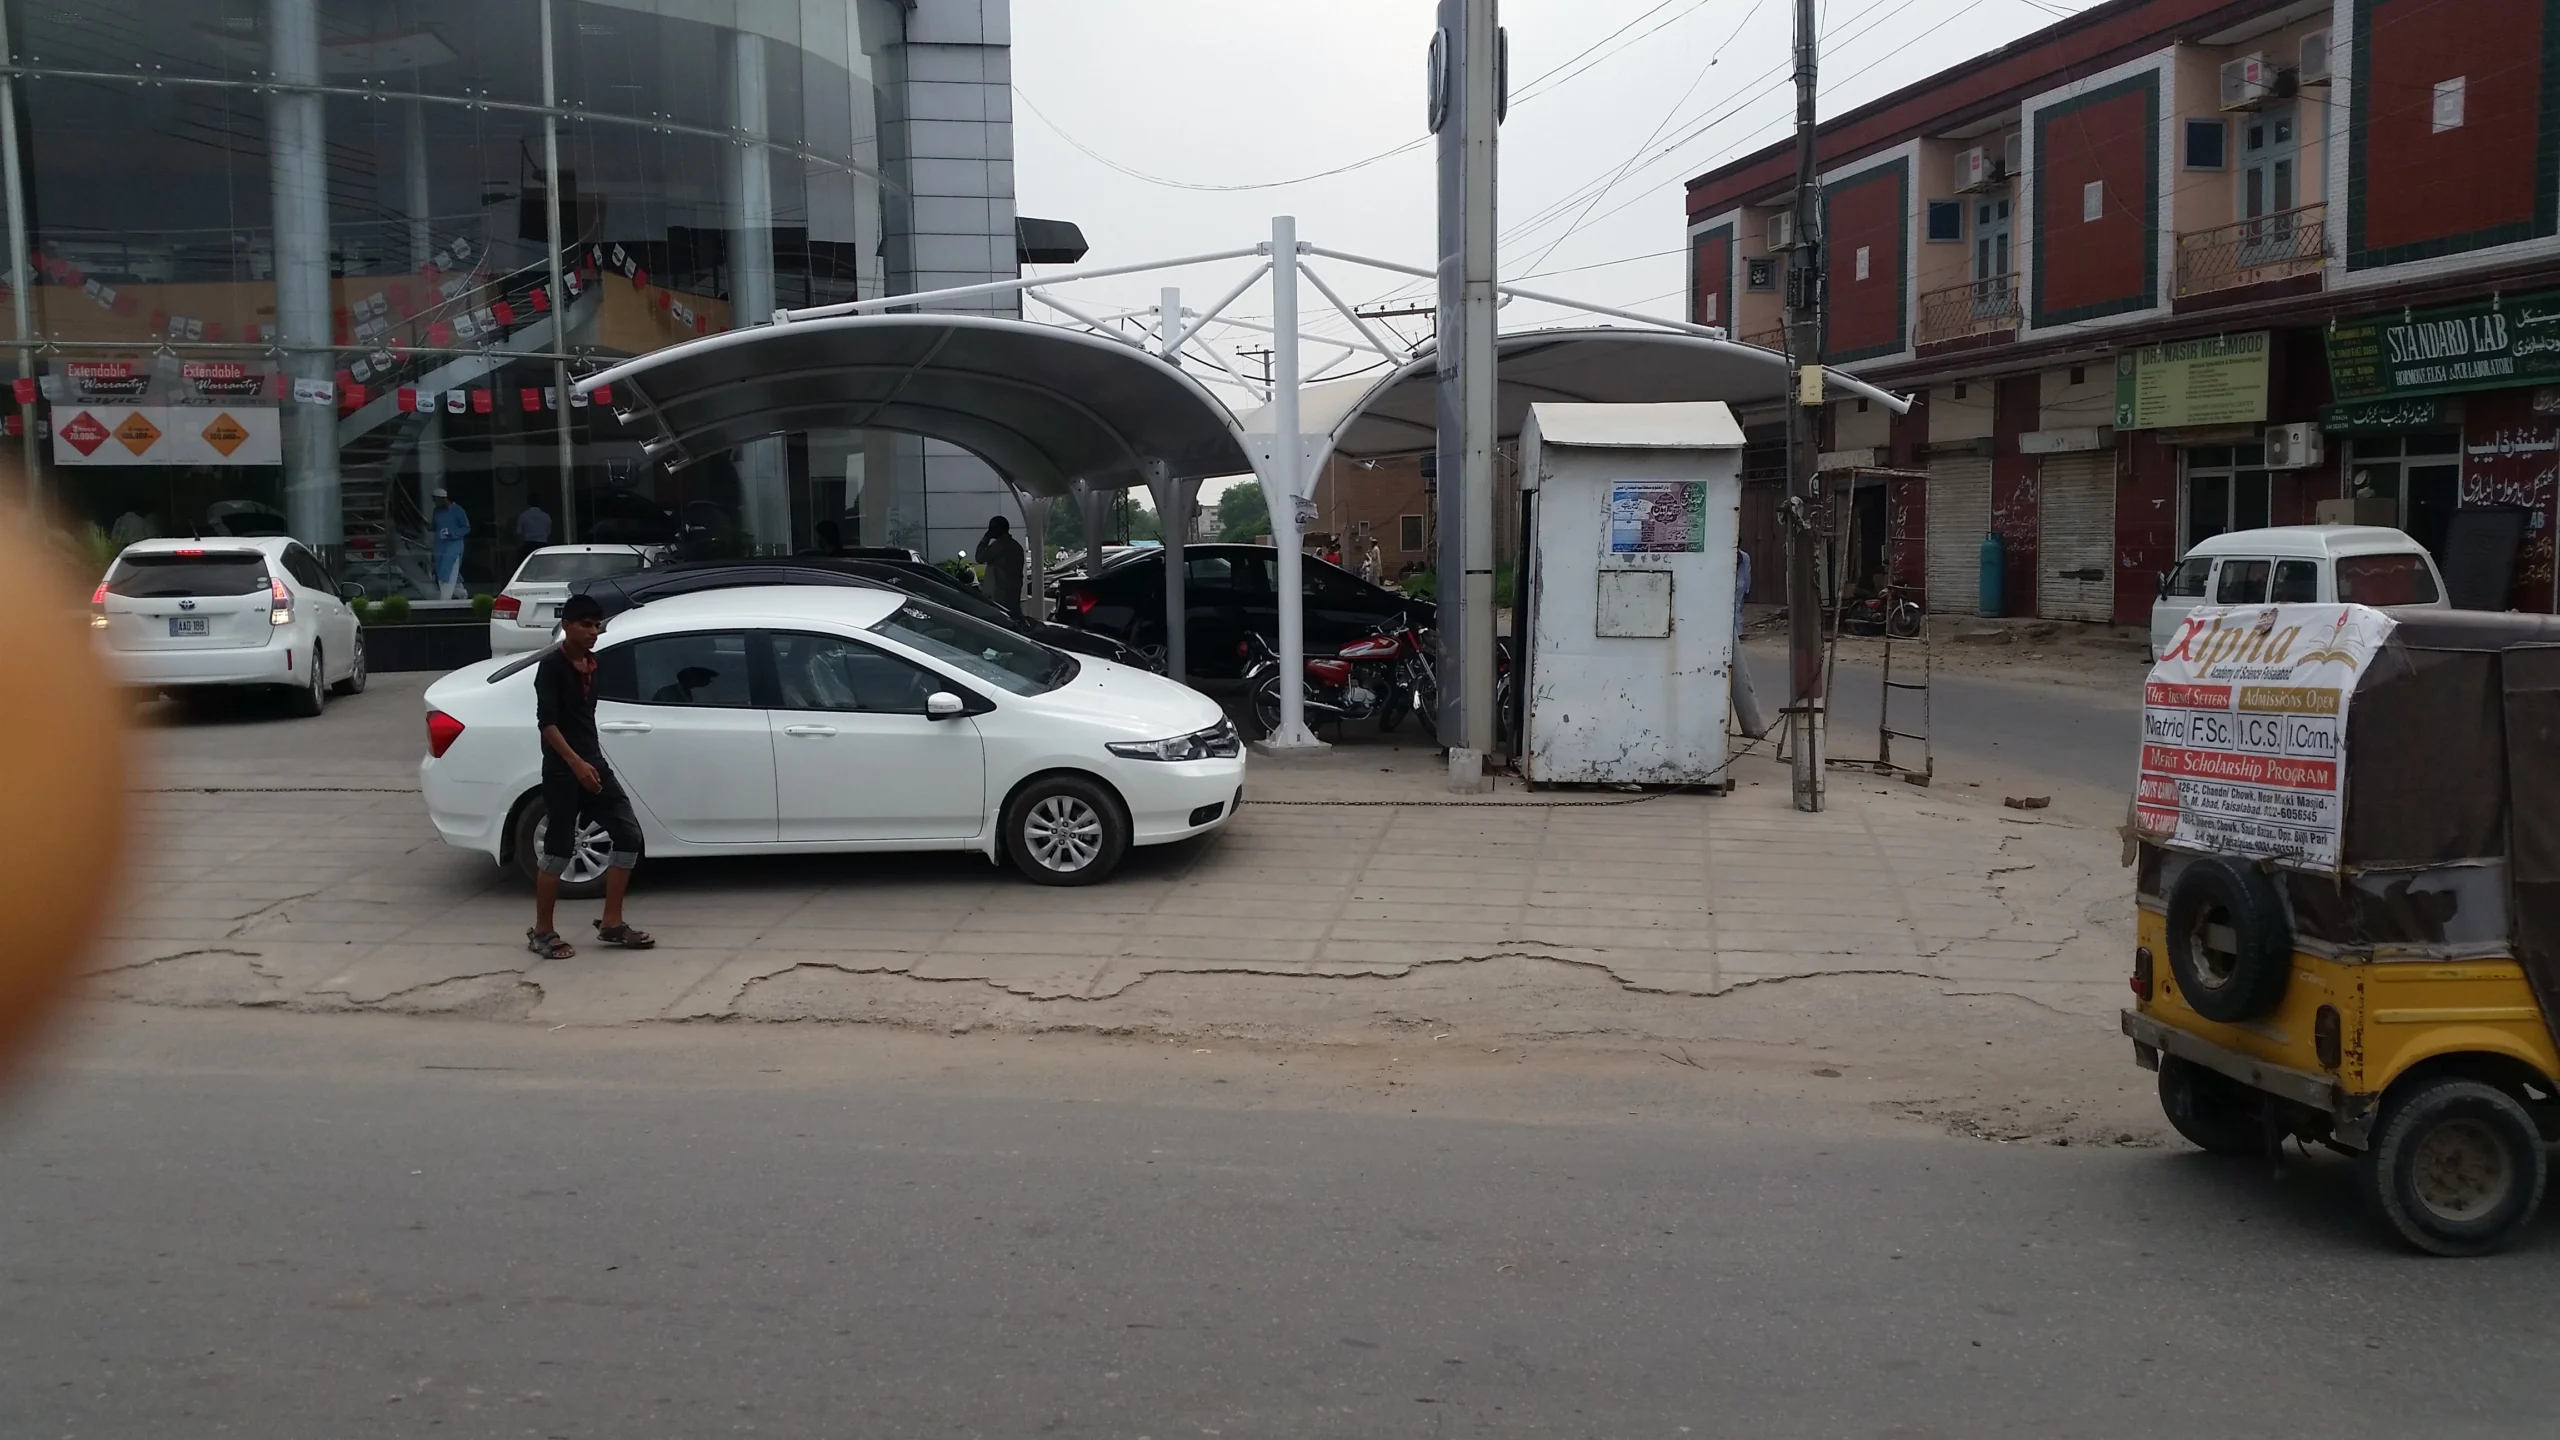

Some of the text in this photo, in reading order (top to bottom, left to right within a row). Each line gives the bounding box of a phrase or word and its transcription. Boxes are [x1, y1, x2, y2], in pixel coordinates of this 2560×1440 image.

[2387, 319, 2468, 363] STANDARD
[2469, 313, 2508, 352] LAB
[2165, 342, 2198, 362] NASIR
[2202, 335, 2263, 358] MEHMOOD
[68, 364, 126, 377] Extendable
[183, 365, 241, 378] Extendable
[2530, 511, 2546, 529] AB
[2209, 666, 2232, 683] Academy
[2240, 667, 2261, 680] Science
[2261, 667, 2293, 680] Faisalabad
[2193, 689, 2228, 706] SETTERS
[2192, 717, 2231, 744] F.Sc.
[2239, 719, 2280, 747] I.C.S.
[2289, 724, 2334, 750] I.Com.
[2202, 785, 2229, 799] Chandni
